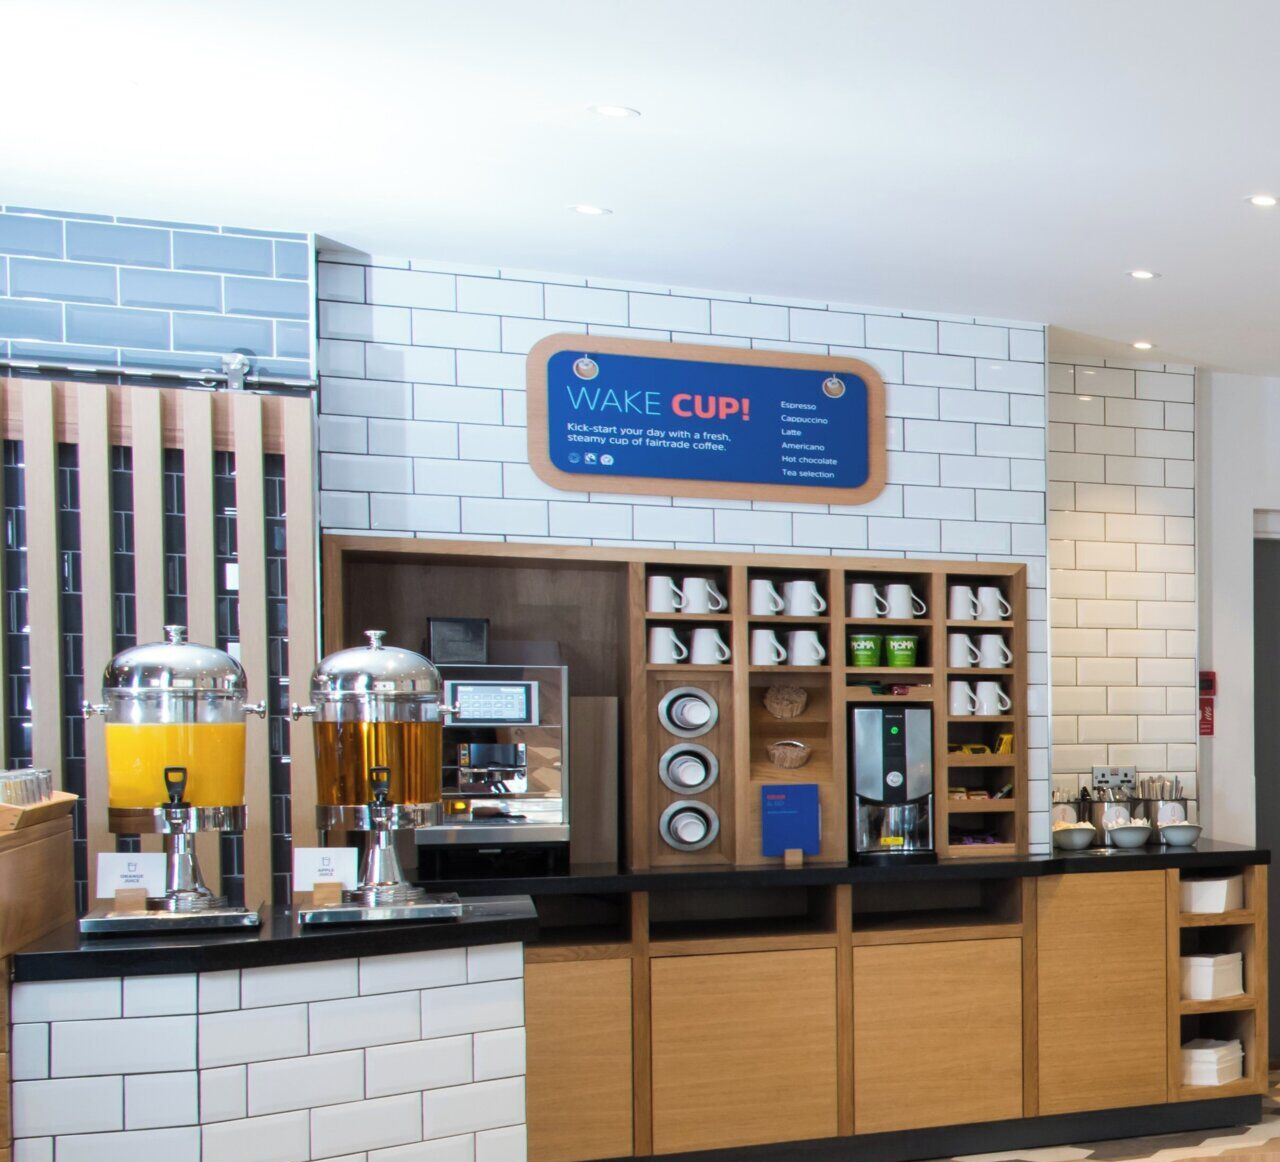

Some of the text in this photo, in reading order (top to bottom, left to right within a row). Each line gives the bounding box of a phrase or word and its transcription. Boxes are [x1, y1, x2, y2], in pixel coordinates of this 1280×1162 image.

[566, 385, 750, 421] WAKE CUP!
[780, 401, 817, 410] Espresso
[781, 414, 828, 425] Cappuccino
[567, 422, 617, 434] Kick-start
[620, 427, 643, 436] your
[646, 428, 665, 438] day
[668, 430, 691, 439] with
[702, 431, 731, 442] fresh,
[781, 428, 802, 436] Latte
[567, 434, 727, 451] steamy cup of fairtrade coffee.
[781, 441, 825, 451] Americano
[781, 455, 838, 465] Hot chocolate
[782, 469, 835, 478] Tea selection
